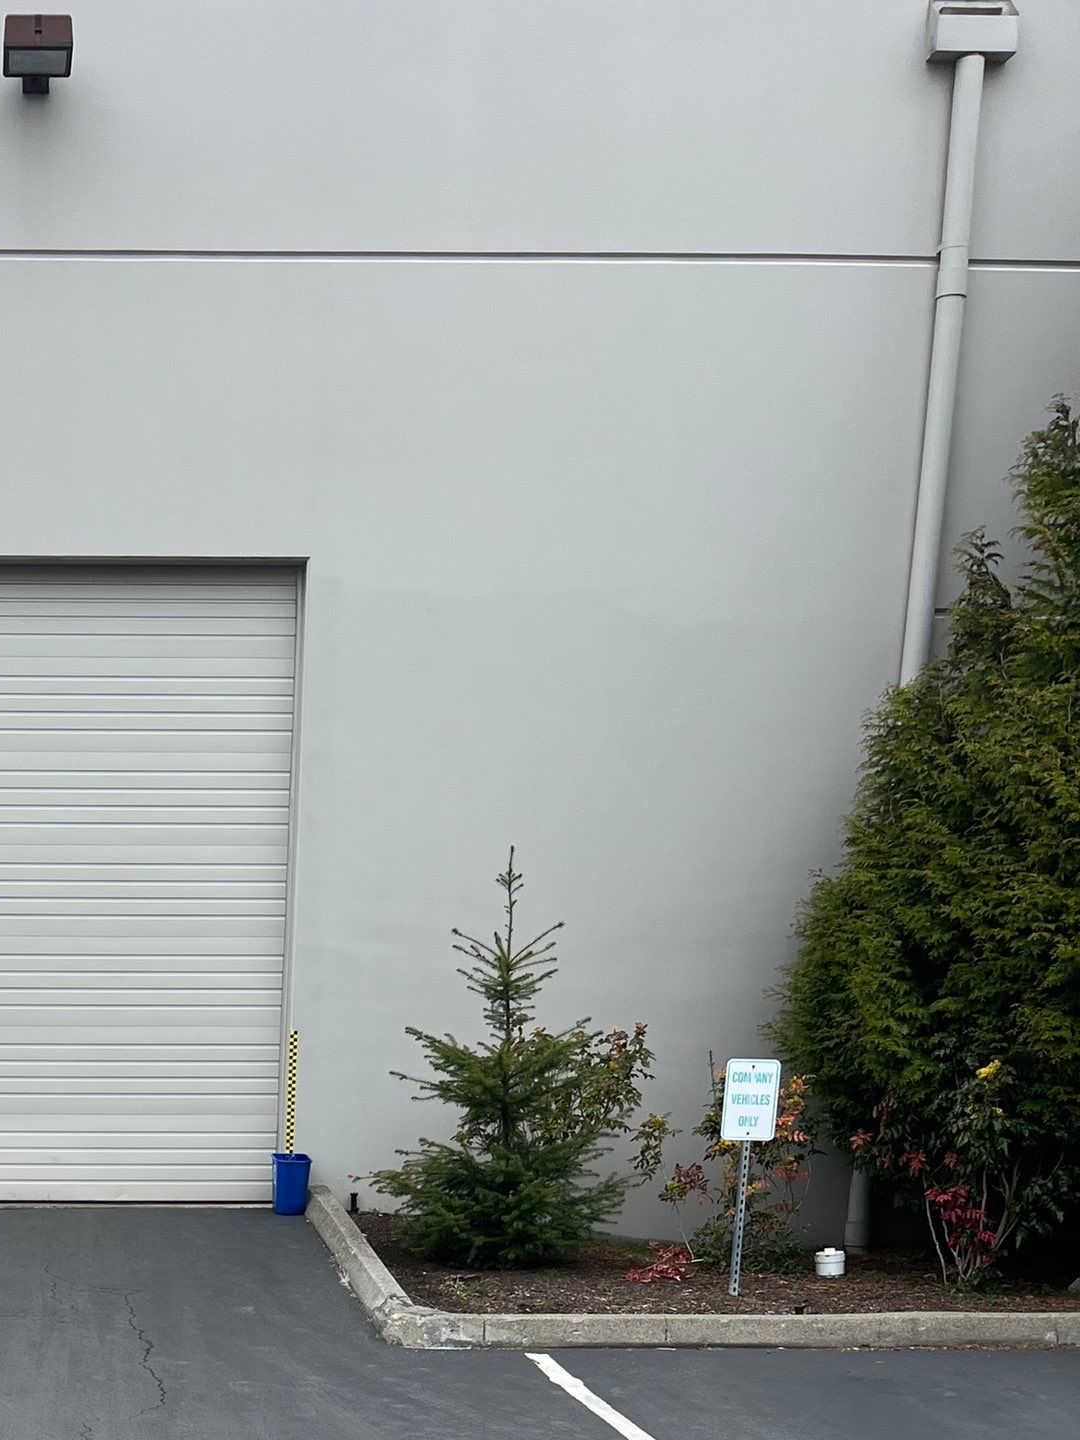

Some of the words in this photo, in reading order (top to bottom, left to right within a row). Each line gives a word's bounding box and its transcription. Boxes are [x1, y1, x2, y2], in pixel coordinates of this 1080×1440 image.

[732, 1071, 773, 1084] COMANY
[732, 1094, 770, 1106] VEHICLES
[738, 1115, 760, 1127] ONLY
